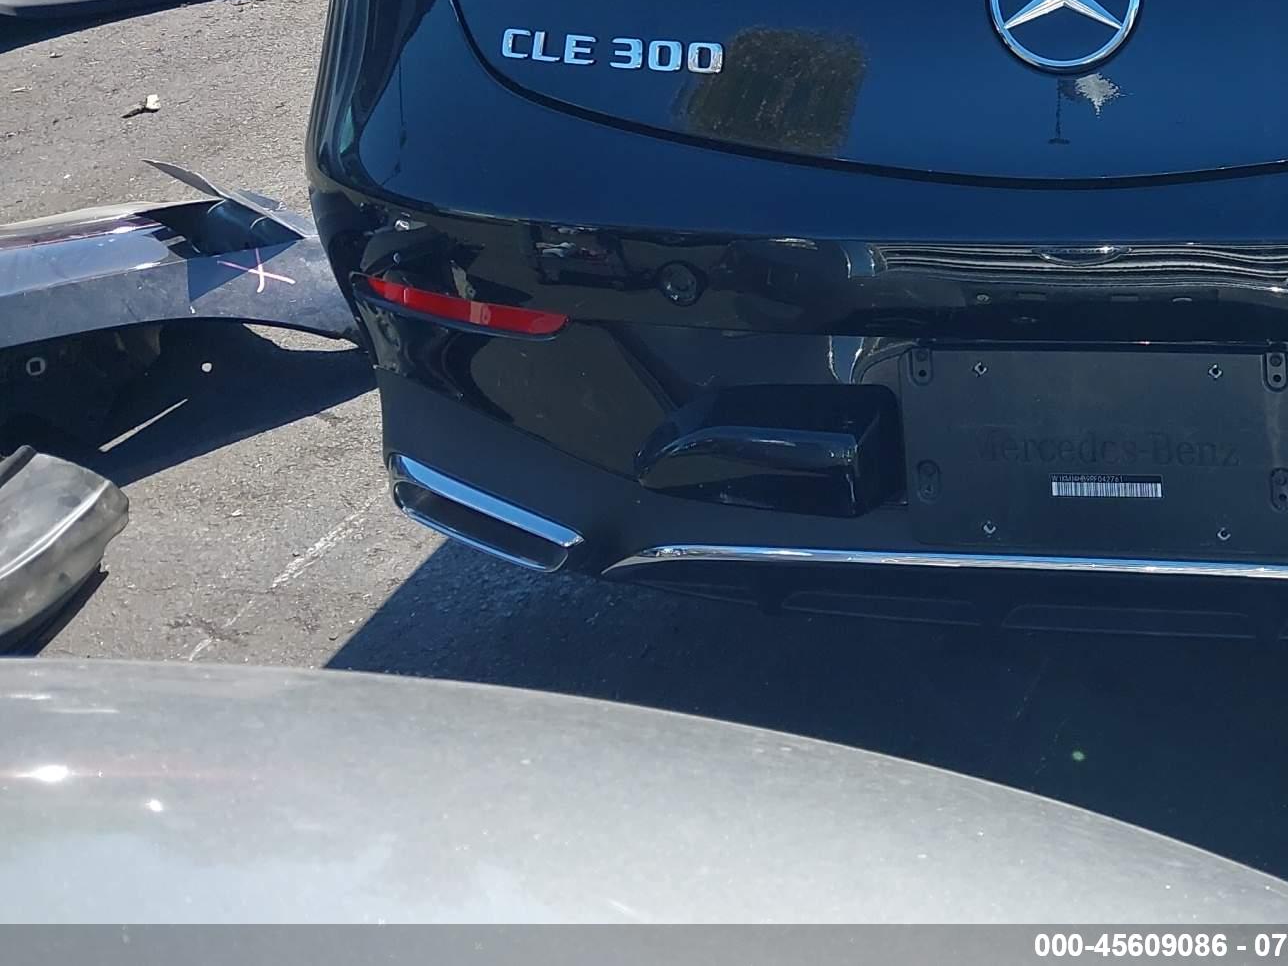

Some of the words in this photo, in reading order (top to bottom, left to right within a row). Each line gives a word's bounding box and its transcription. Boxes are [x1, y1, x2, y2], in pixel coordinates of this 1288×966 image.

[501, 27, 597, 66] CLE
[608, 37, 724, 75] 300
[976, 427, 1241, 467] Mercedes-Benz
